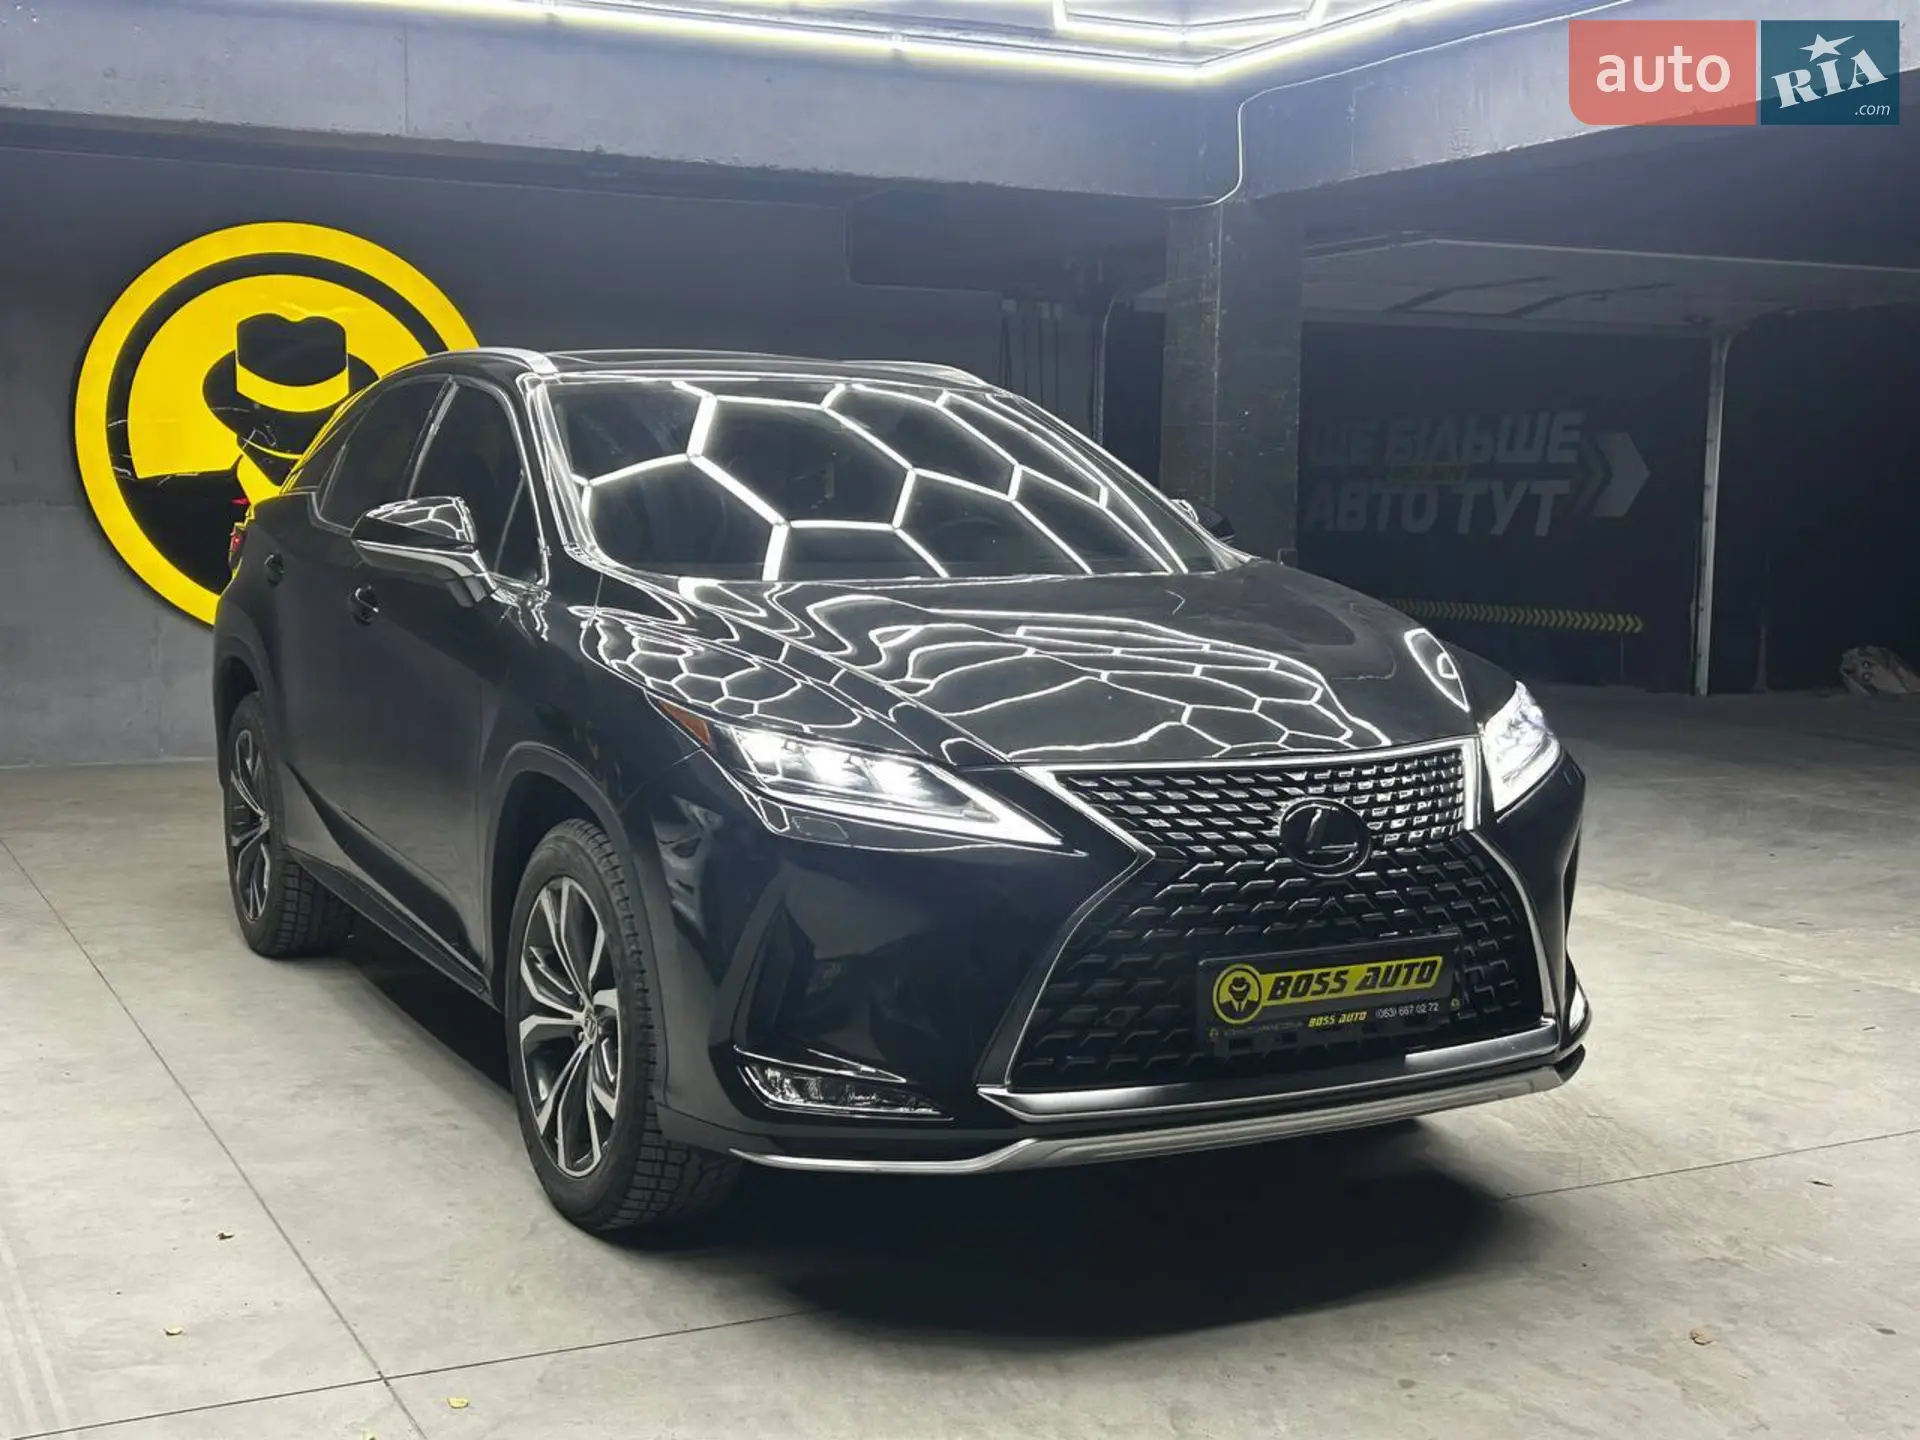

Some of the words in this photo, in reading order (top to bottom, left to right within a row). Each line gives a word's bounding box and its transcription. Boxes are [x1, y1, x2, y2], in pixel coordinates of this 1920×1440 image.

[1384, 411, 1586, 464] БІЛЬШЕ
[1302, 480, 1439, 534] АВТО
[1449, 480, 1573, 537] ТУТ
[1267, 968, 1349, 1001] BOSS
[1354, 960, 1439, 991] AUTO
[1308, 1016, 1335, 1028] BOSS
[1338, 1011, 1368, 1024] AUTO
